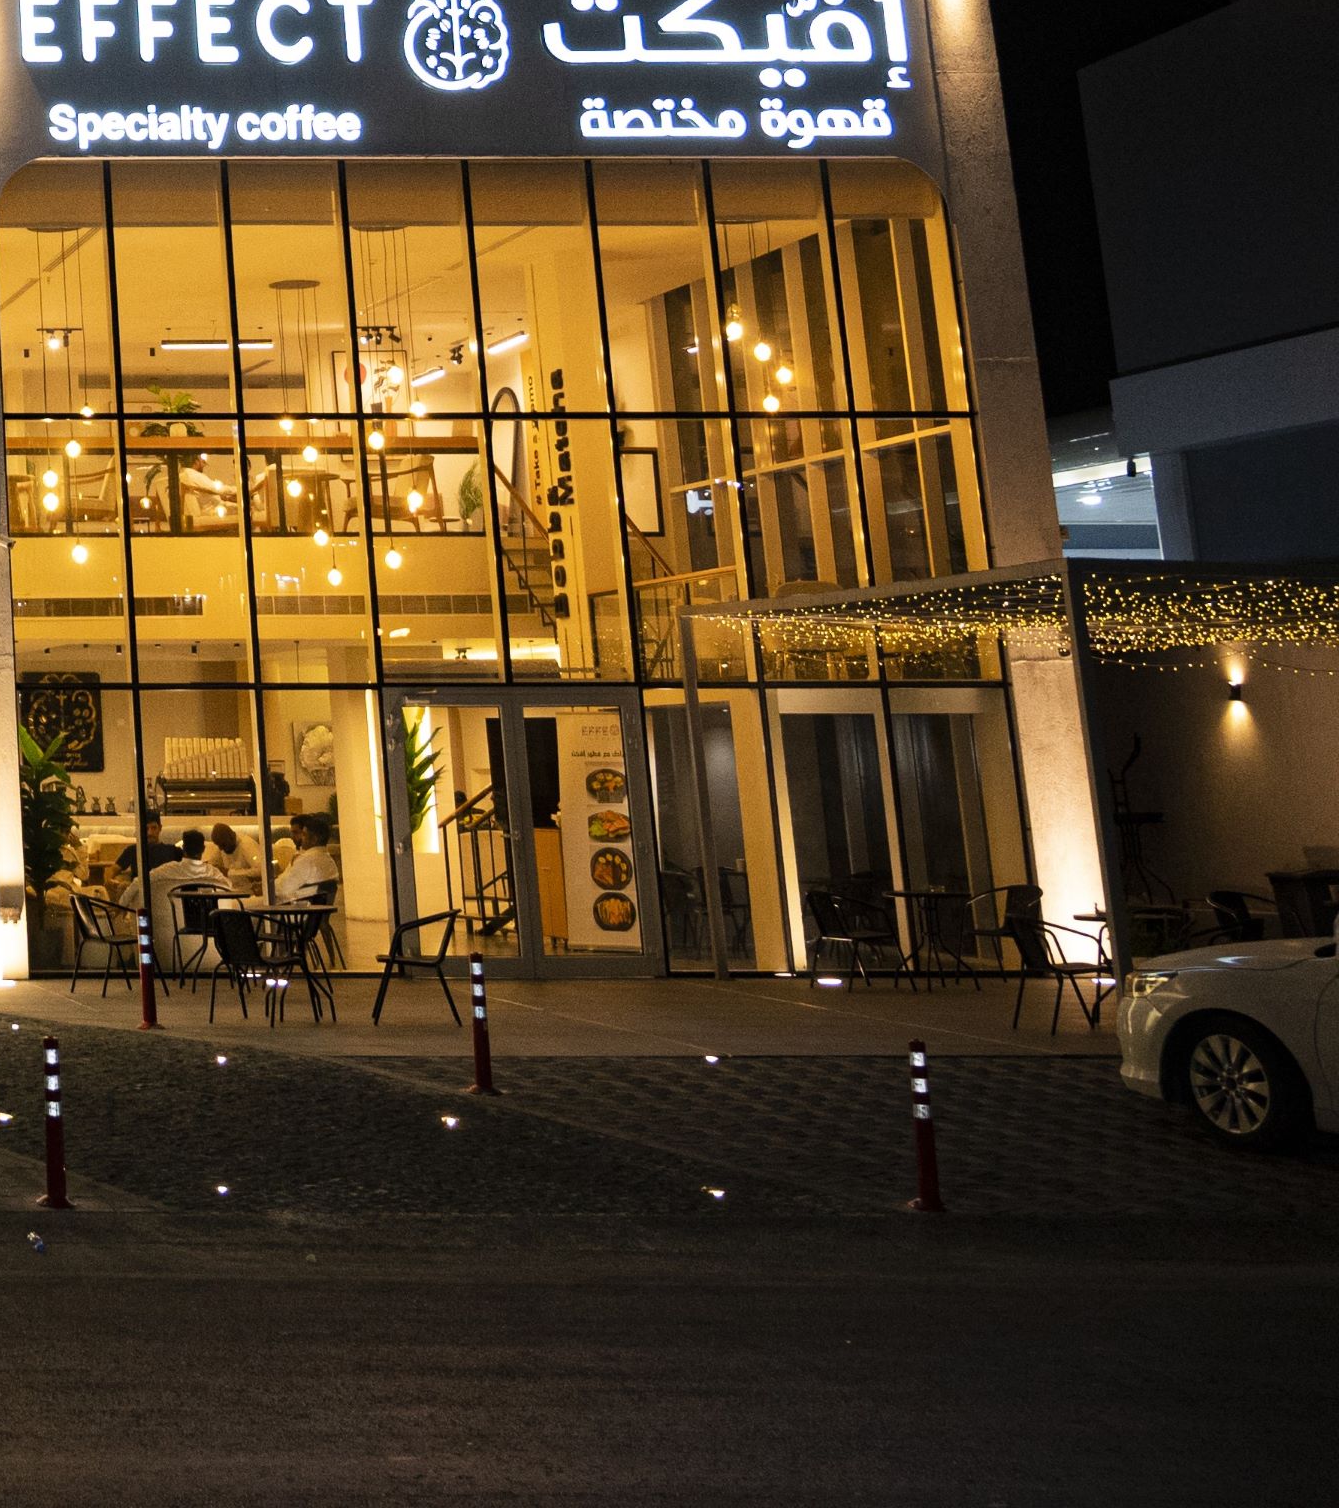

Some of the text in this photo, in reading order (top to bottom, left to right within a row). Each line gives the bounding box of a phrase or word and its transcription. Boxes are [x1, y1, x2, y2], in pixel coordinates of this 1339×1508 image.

[48, 103, 363, 150] Specialty coffee
[578, 96, 893, 149] قهوة مختصة
[533, 449, 542, 490] Take
